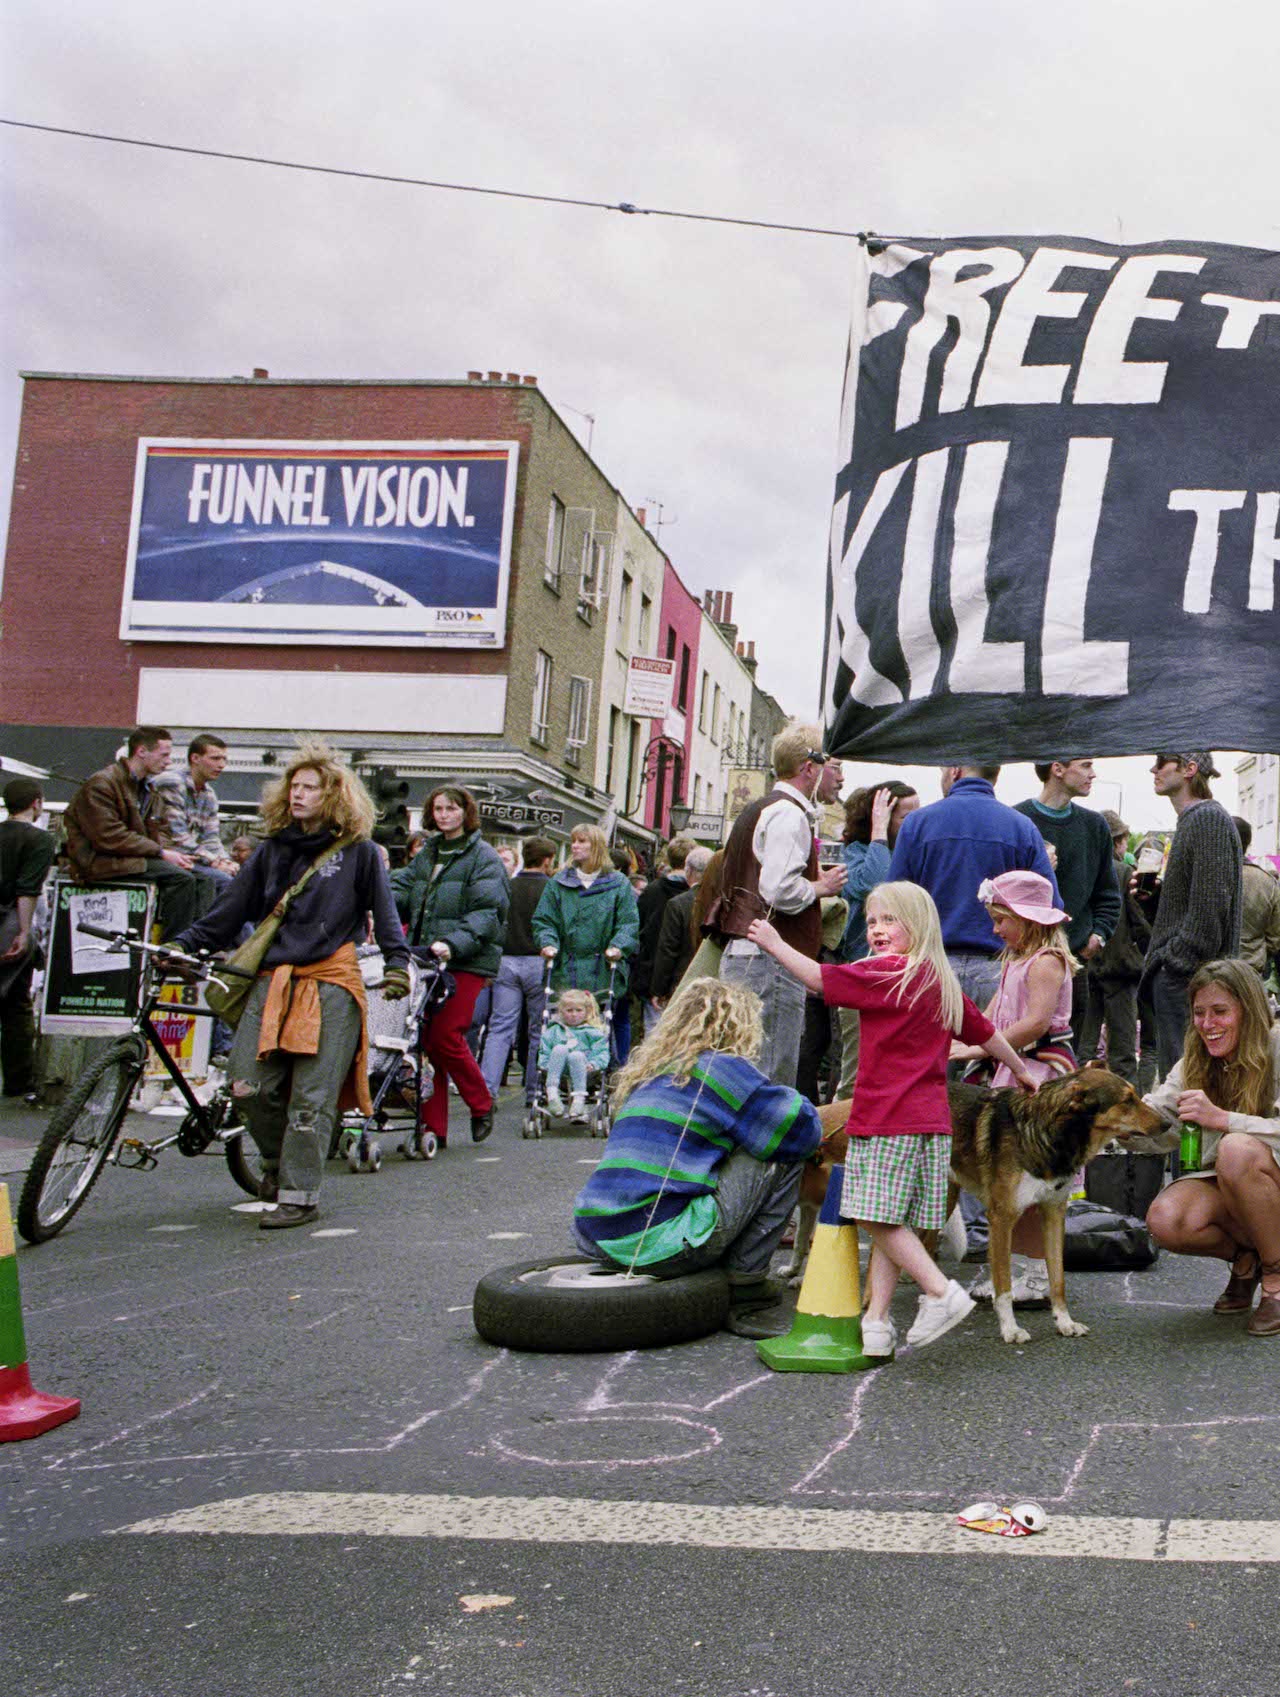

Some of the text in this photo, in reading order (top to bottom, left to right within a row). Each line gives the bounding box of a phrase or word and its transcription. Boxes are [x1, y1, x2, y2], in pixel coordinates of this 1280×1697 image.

[862, 243, 1207, 432] FREE
[189, 463, 475, 528] FUNNEL VISION.
[826, 437, 1130, 712] KILL
[436, 610, 465, 621] P&O
[481, 803, 561, 824] metal tec
[701, 823, 719, 831] CUT
